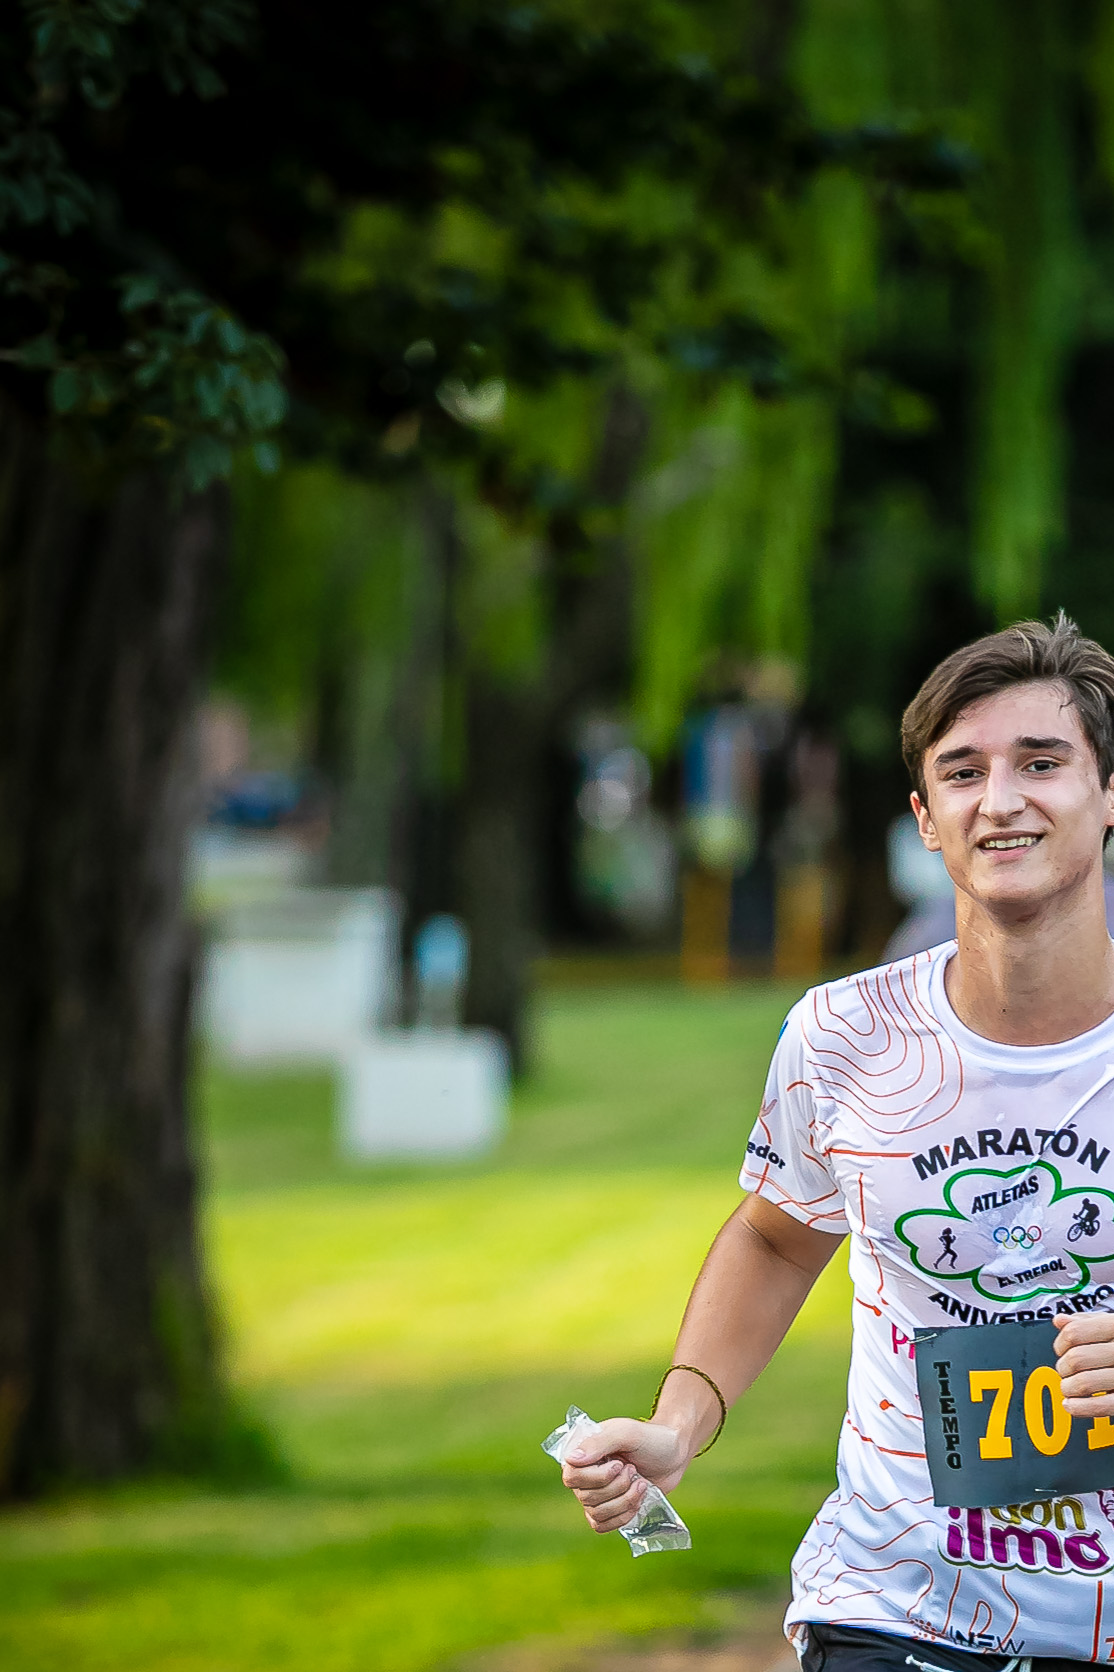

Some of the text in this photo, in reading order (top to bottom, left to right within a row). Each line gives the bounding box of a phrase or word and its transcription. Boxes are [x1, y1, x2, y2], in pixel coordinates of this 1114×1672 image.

[911, 1123, 1111, 1181] MARATÓN
[971, 1175, 1039, 1214] ATLETAS
[933, 1361, 962, 1470] TIEMPO
